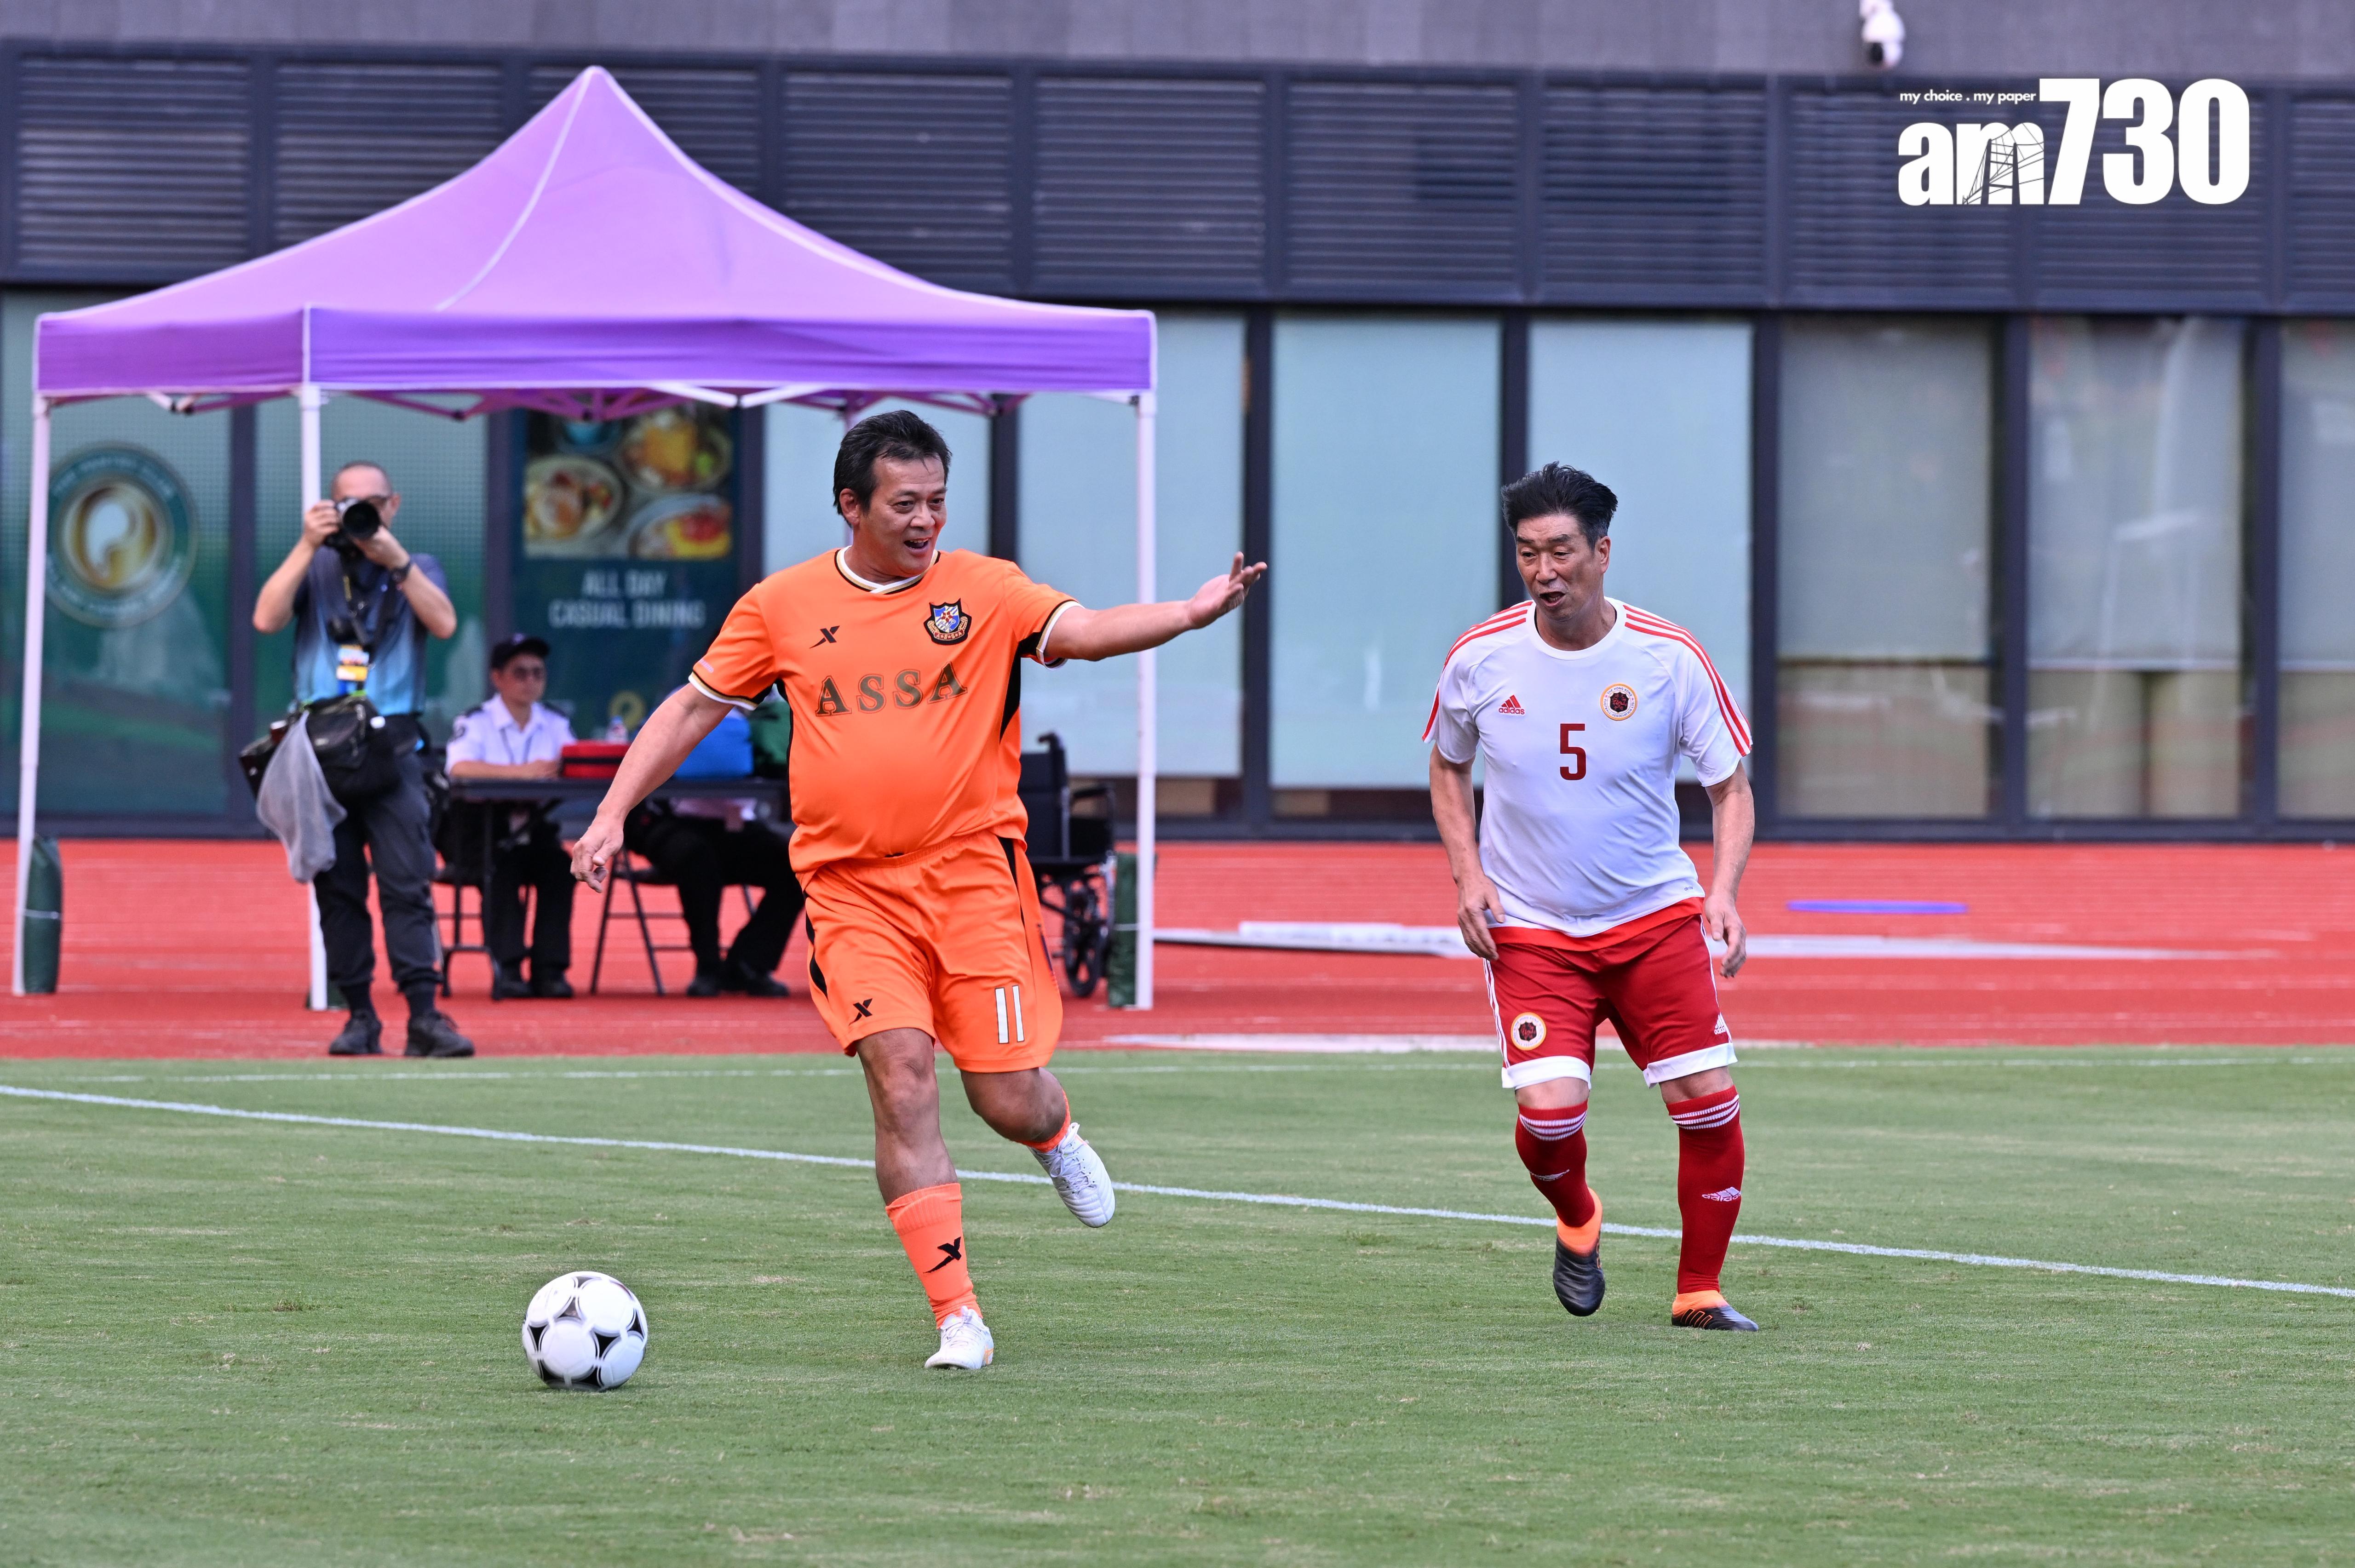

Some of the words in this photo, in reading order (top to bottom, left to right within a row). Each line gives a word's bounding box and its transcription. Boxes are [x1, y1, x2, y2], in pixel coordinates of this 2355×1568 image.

[815, 661, 968, 717] ASSA
[1499, 706, 1525, 715] adidas
[1559, 723, 1586, 781] 5
[995, 985, 1025, 1044] 11
